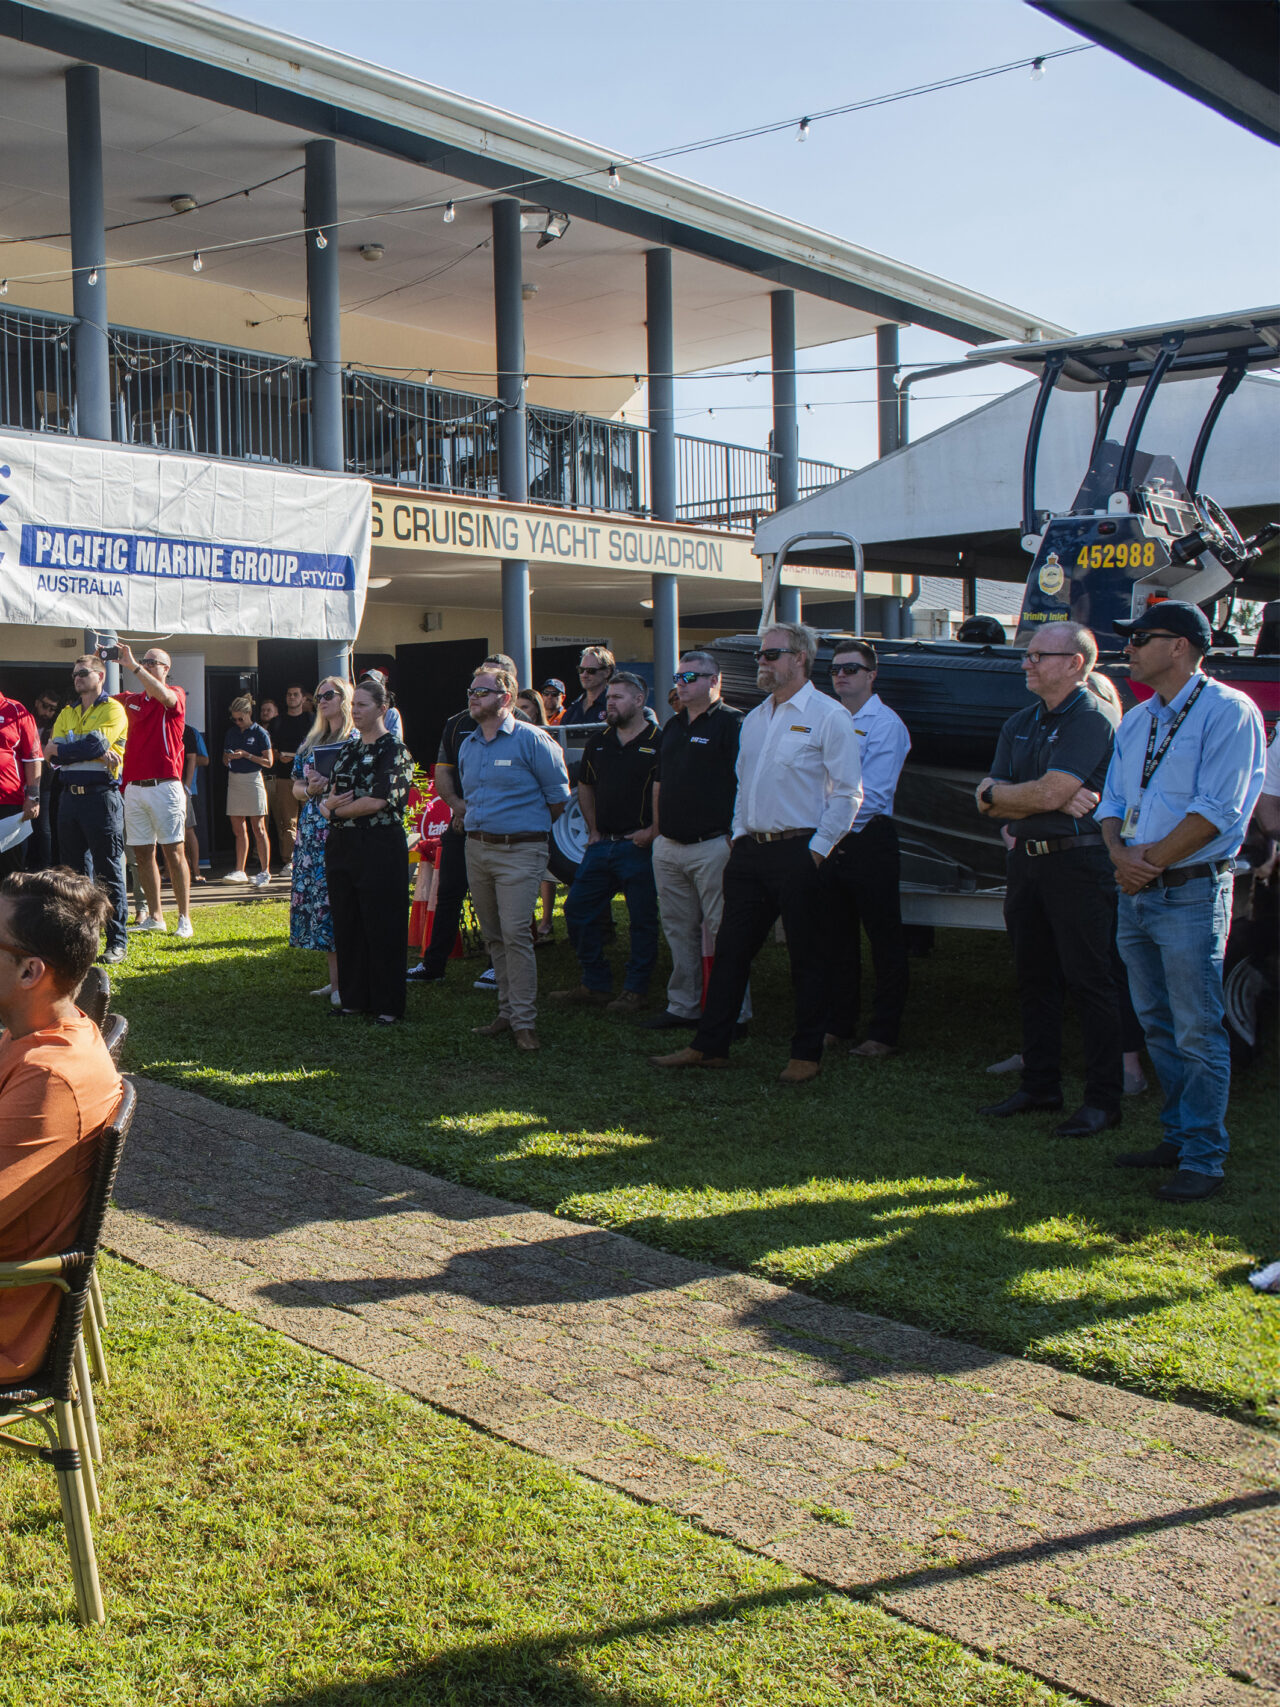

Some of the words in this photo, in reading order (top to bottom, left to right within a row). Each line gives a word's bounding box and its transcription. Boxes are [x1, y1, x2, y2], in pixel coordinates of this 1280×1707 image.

[393, 504, 519, 551] CRUISING
[525, 519, 601, 560] YACHT
[608, 529, 723, 573] SQUADRON
[35, 530, 129, 571] PACIFIC
[135, 540, 225, 579] MARINE
[230, 549, 299, 585] GROUP
[1076, 541, 1156, 569] 452988
[36, 573, 124, 597] AUSTRALIA
[1023, 611, 1048, 623] Trinity
[1049, 612, 1068, 621] Inlet
